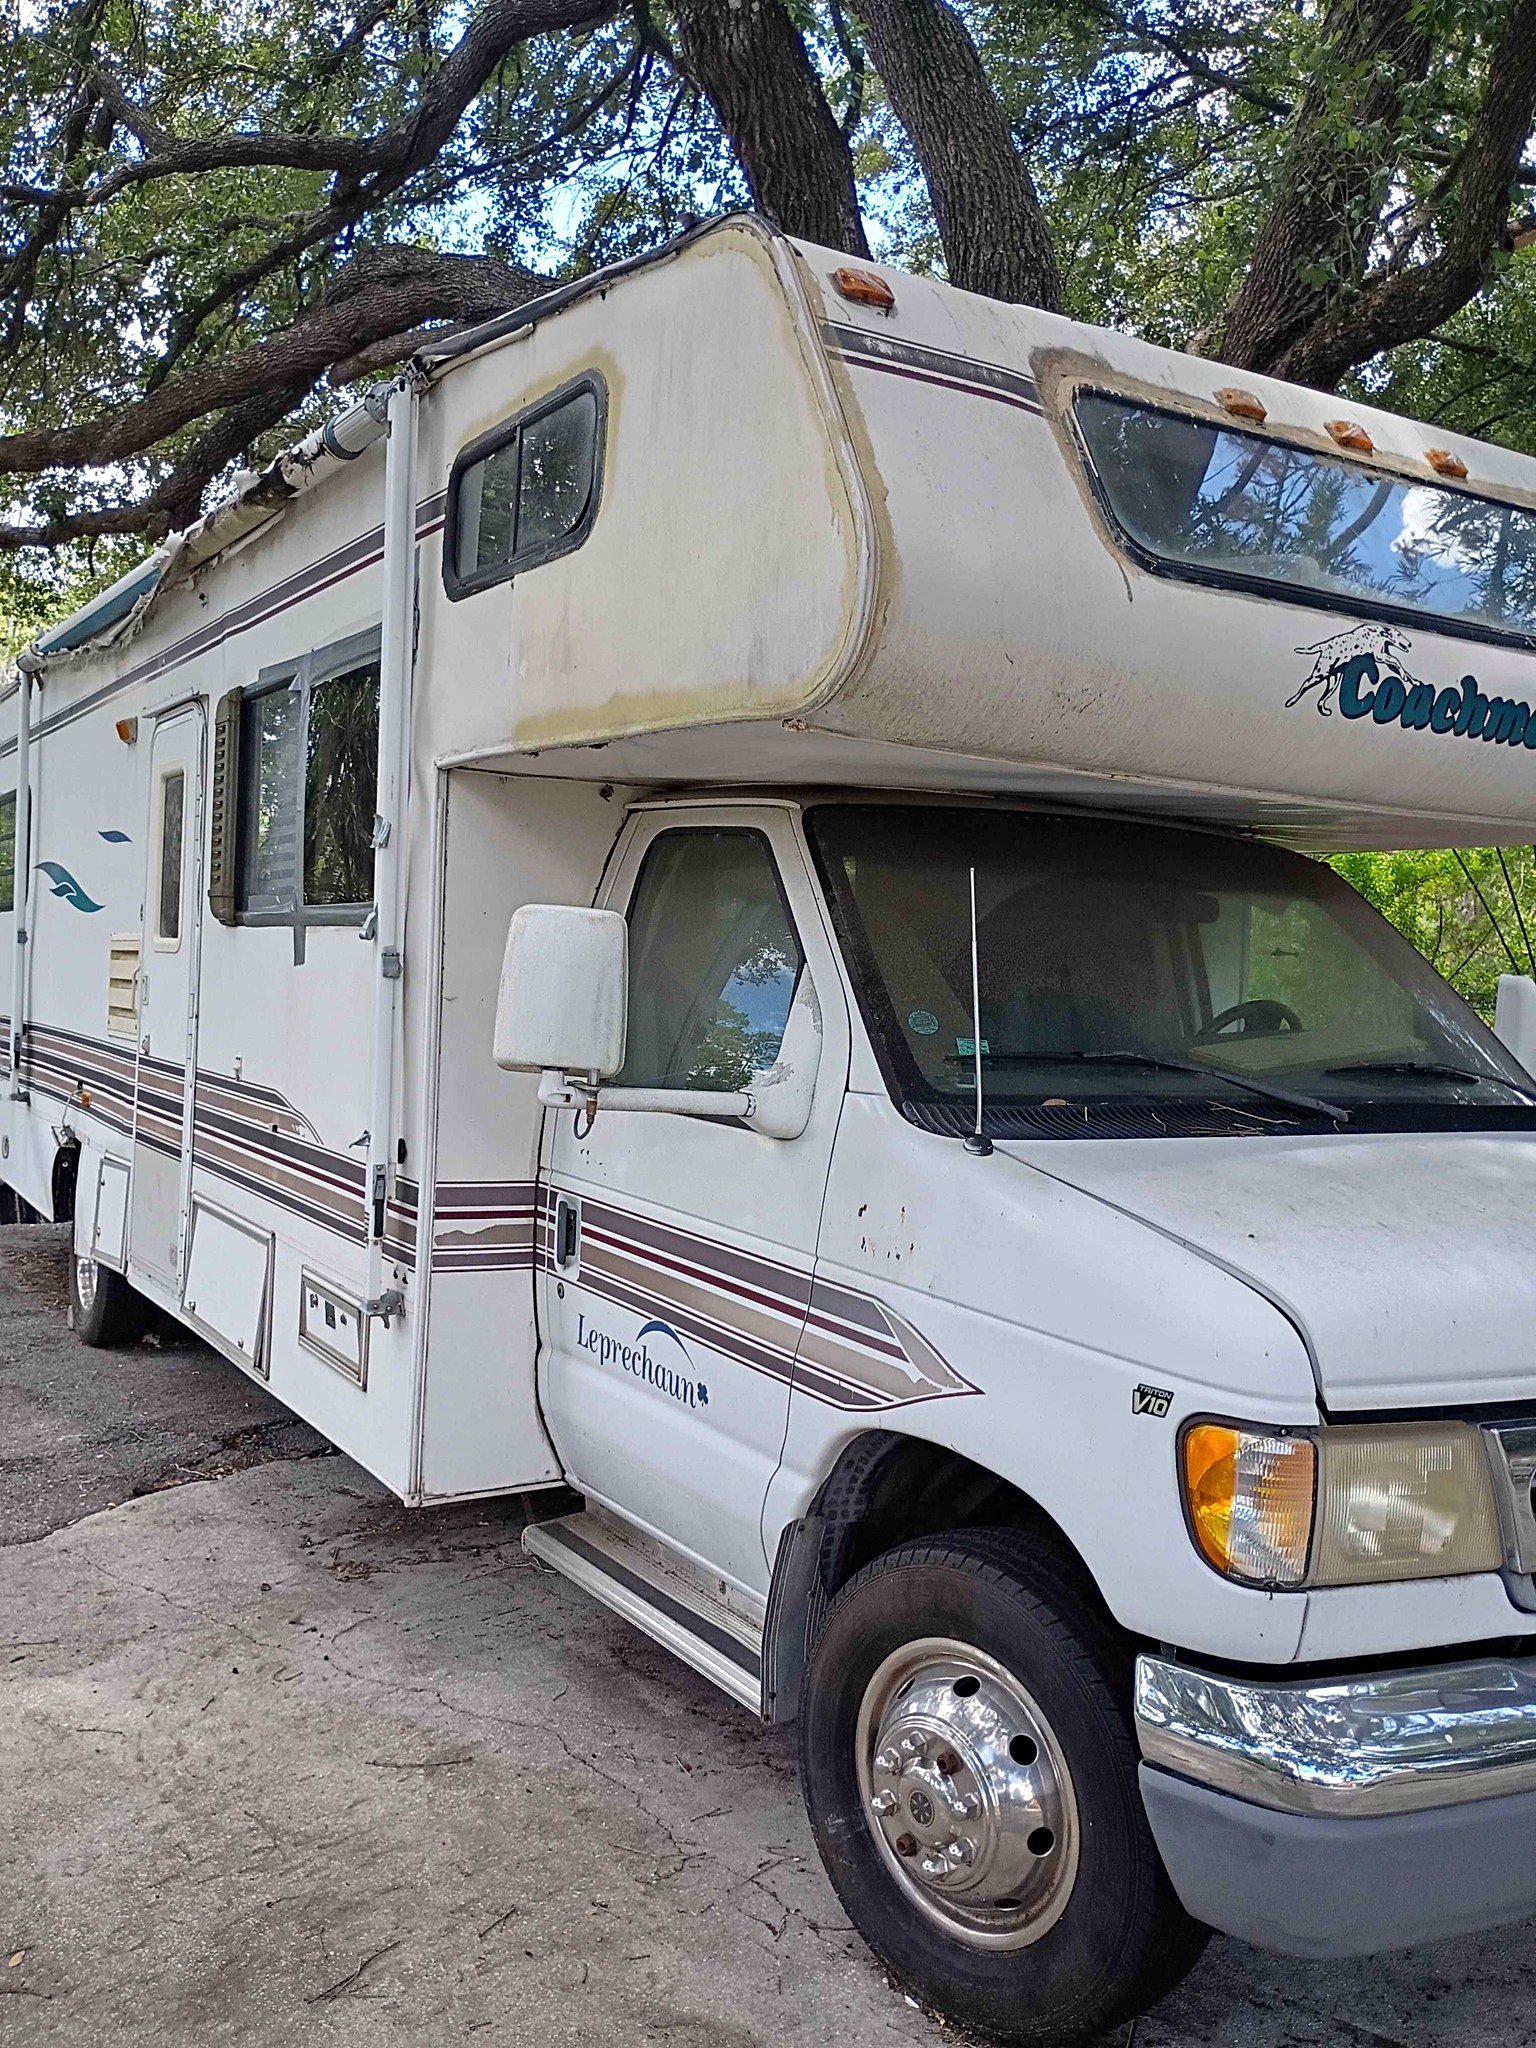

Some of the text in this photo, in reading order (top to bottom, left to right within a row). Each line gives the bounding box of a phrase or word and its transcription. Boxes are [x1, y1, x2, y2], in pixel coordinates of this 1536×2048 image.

[576, 1313, 697, 1409] Leprechaun
[1132, 1390, 1169, 1417] V10
[1139, 1384, 1173, 1400] TRITON
